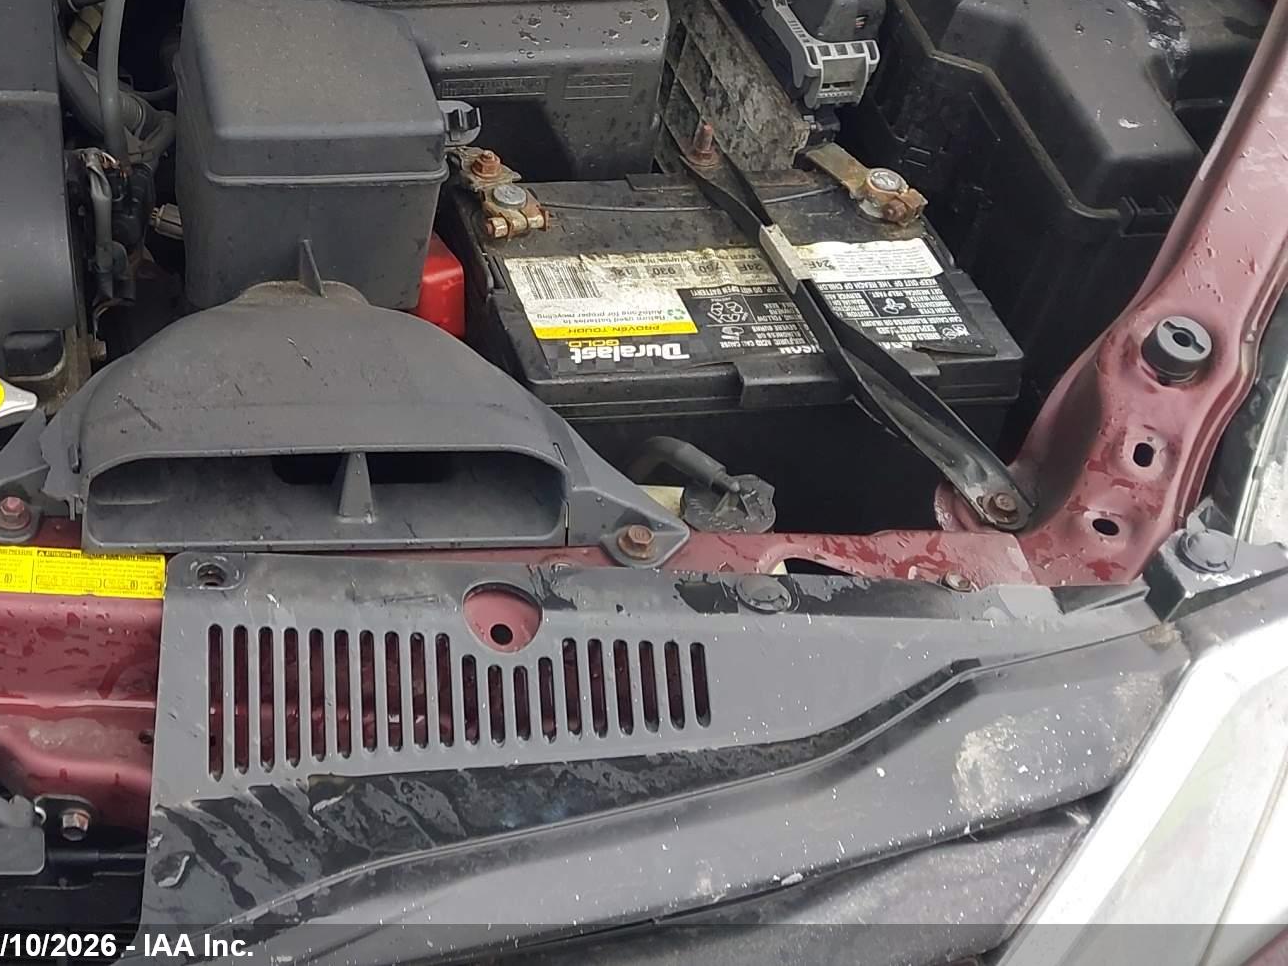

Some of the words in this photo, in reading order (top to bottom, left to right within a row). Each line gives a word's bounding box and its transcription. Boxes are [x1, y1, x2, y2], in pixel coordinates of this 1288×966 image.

[653, 266, 676, 275] 930
[852, 281, 878, 289] REACH
[690, 288, 722, 297] BATTERY!
[577, 310, 605, 318] proper
[568, 326, 608, 334] TOUGH
[612, 325, 660, 333] PROVEN
[569, 344, 690, 364] Duralast
